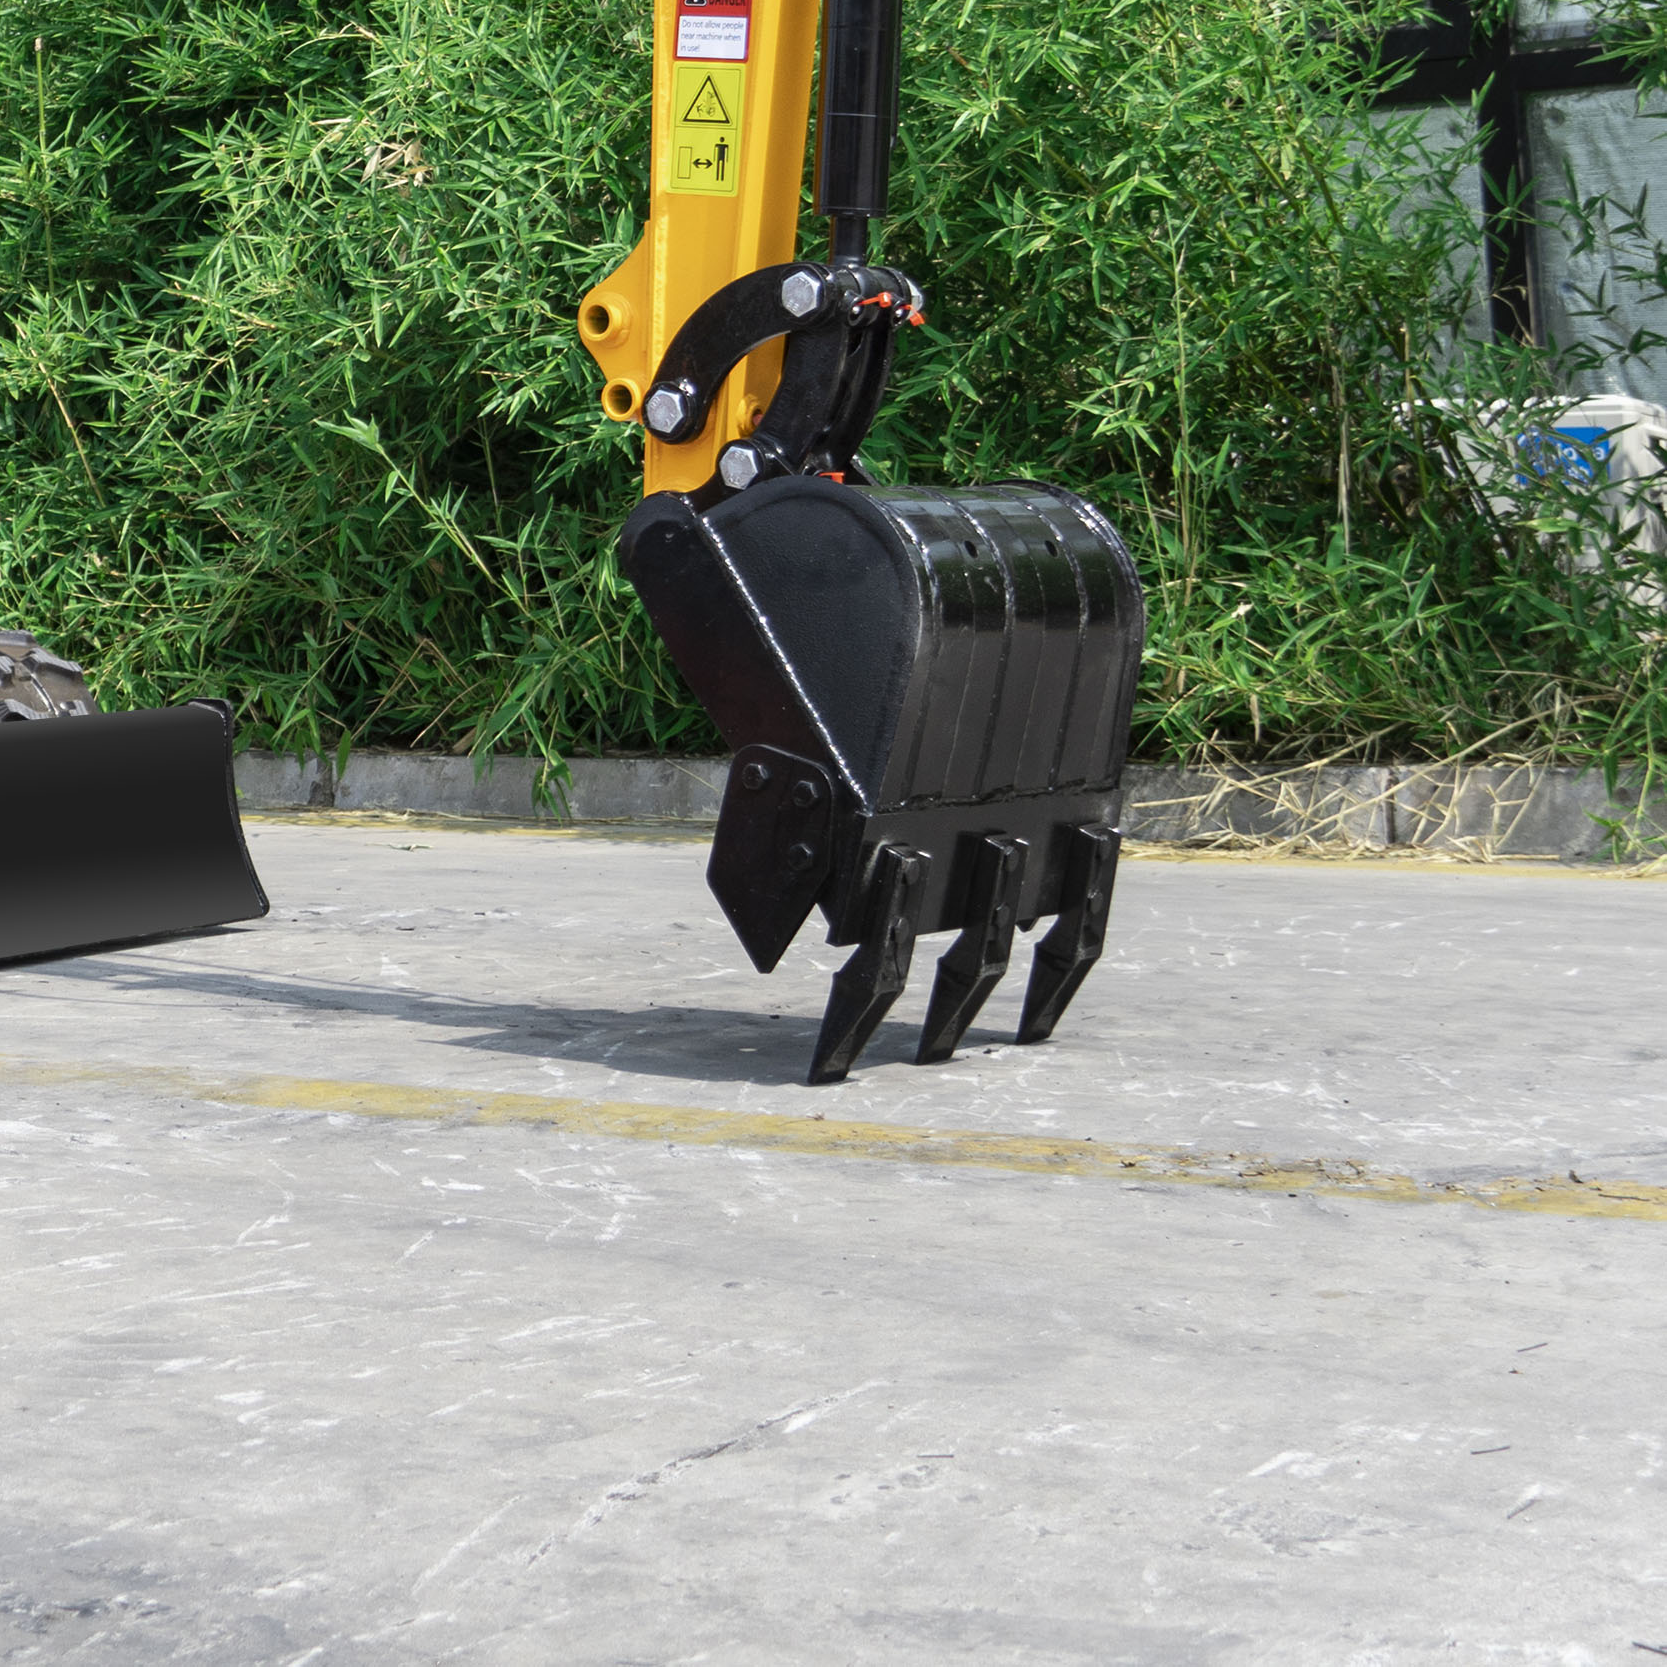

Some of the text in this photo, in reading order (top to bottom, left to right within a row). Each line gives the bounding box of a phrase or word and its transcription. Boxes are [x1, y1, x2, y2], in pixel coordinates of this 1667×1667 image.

[682, 20, 691, 28] Do
[705, 20, 720, 29] allow
[722, 22, 744, 31] people
[696, 32, 722, 40] machine
[724, 33, 741, 41] when
